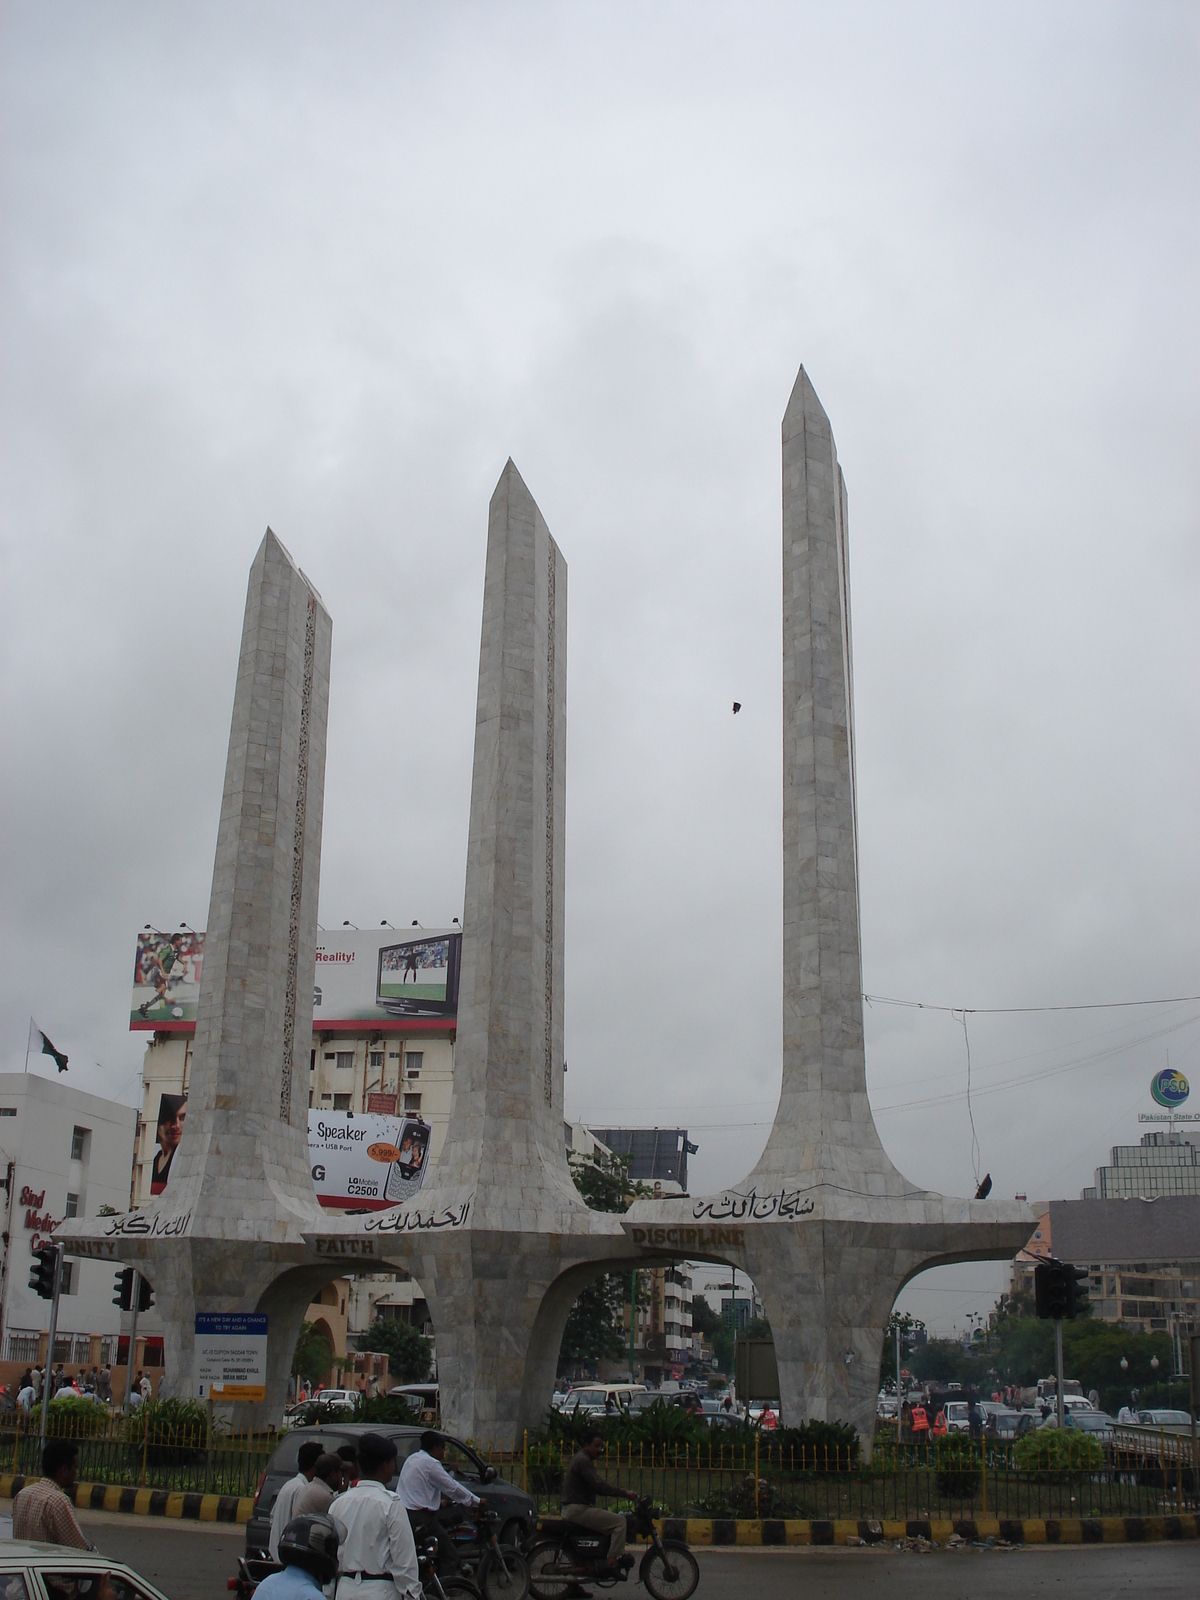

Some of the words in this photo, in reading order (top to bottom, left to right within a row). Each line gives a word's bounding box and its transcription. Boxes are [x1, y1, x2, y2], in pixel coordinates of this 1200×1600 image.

[315, 952, 355, 963] Reality!
[1161, 1079, 1187, 1092] PSO
[317, 1121, 367, 1141] Speaker
[20, 1186, 46, 1209] Sind
[347, 1185, 378, 1196] C2500
[632, 1228, 745, 1246] DISCIPLINE
[63, 1240, 115, 1256] UNITY
[315, 1239, 374, 1254] FAITH
